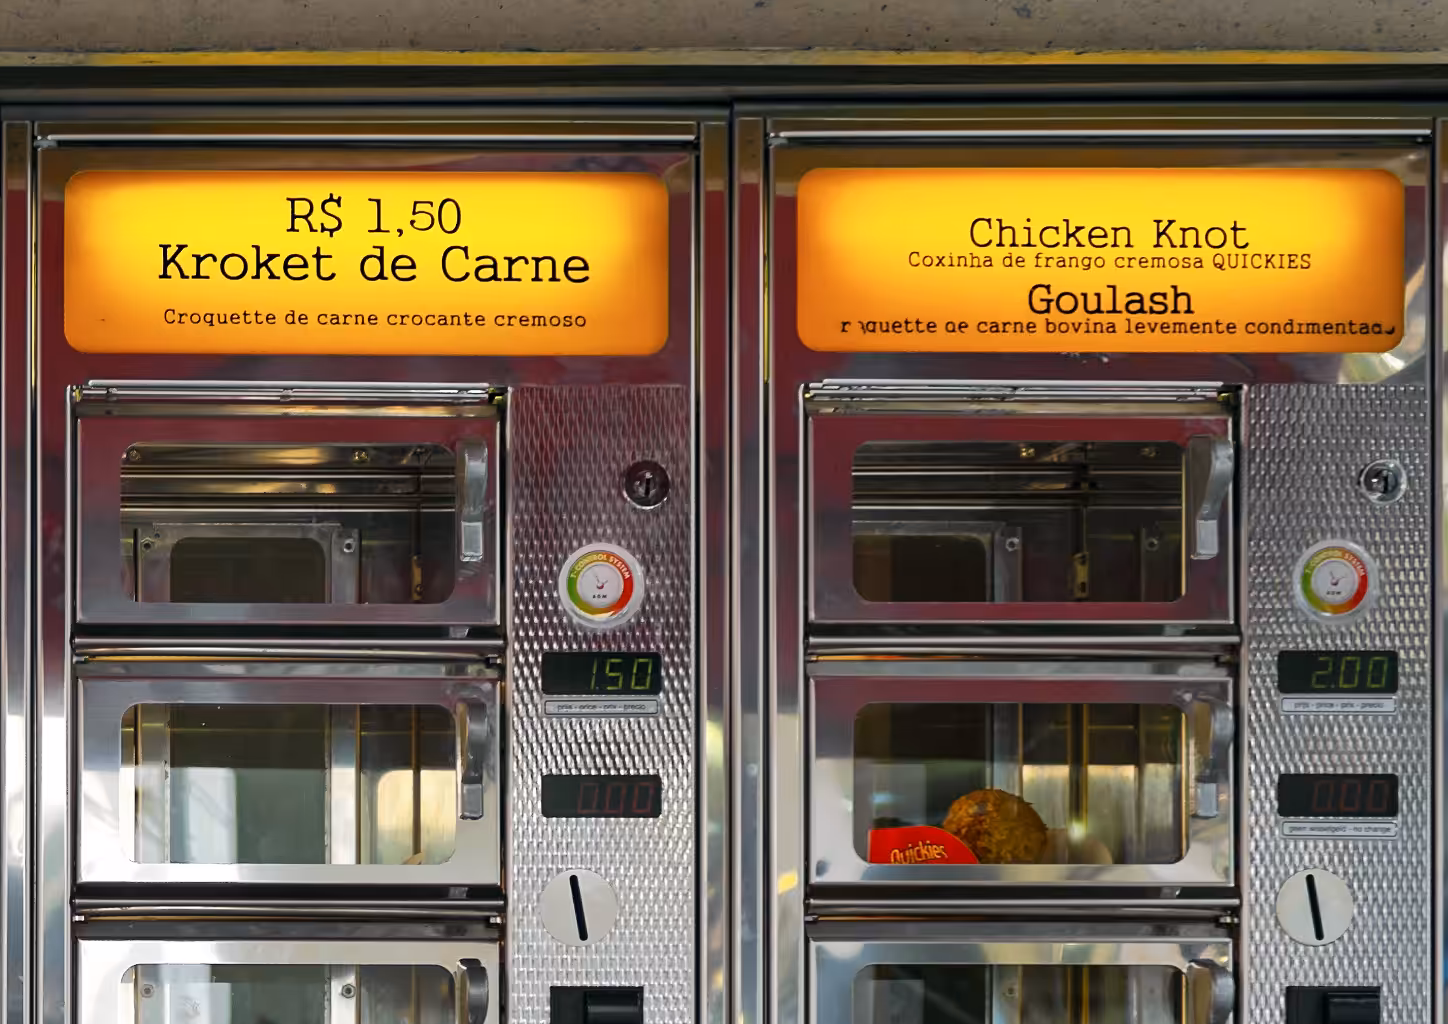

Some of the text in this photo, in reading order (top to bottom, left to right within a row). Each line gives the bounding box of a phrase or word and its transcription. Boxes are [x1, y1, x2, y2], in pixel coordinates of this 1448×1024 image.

[286, 193, 462, 238] R$ 1,50
[969, 217, 1250, 250] Chicken Knot
[158, 243, 590, 283] Kroket de Carne
[908, 251, 1311, 271] Coxinha de frango cremosa QUICKIES
[1027, 283, 1195, 315] Goulash
[163, 308, 587, 328] Croquette de carne crocante cremoso
[976, 321, 1037, 334] carne
[1044, 317, 1117, 334] bovina
[1124, 318, 1237, 335] levemente
[609, 555, 631, 580] SYSTEM
[1312, 656, 1388, 688] 2.00
